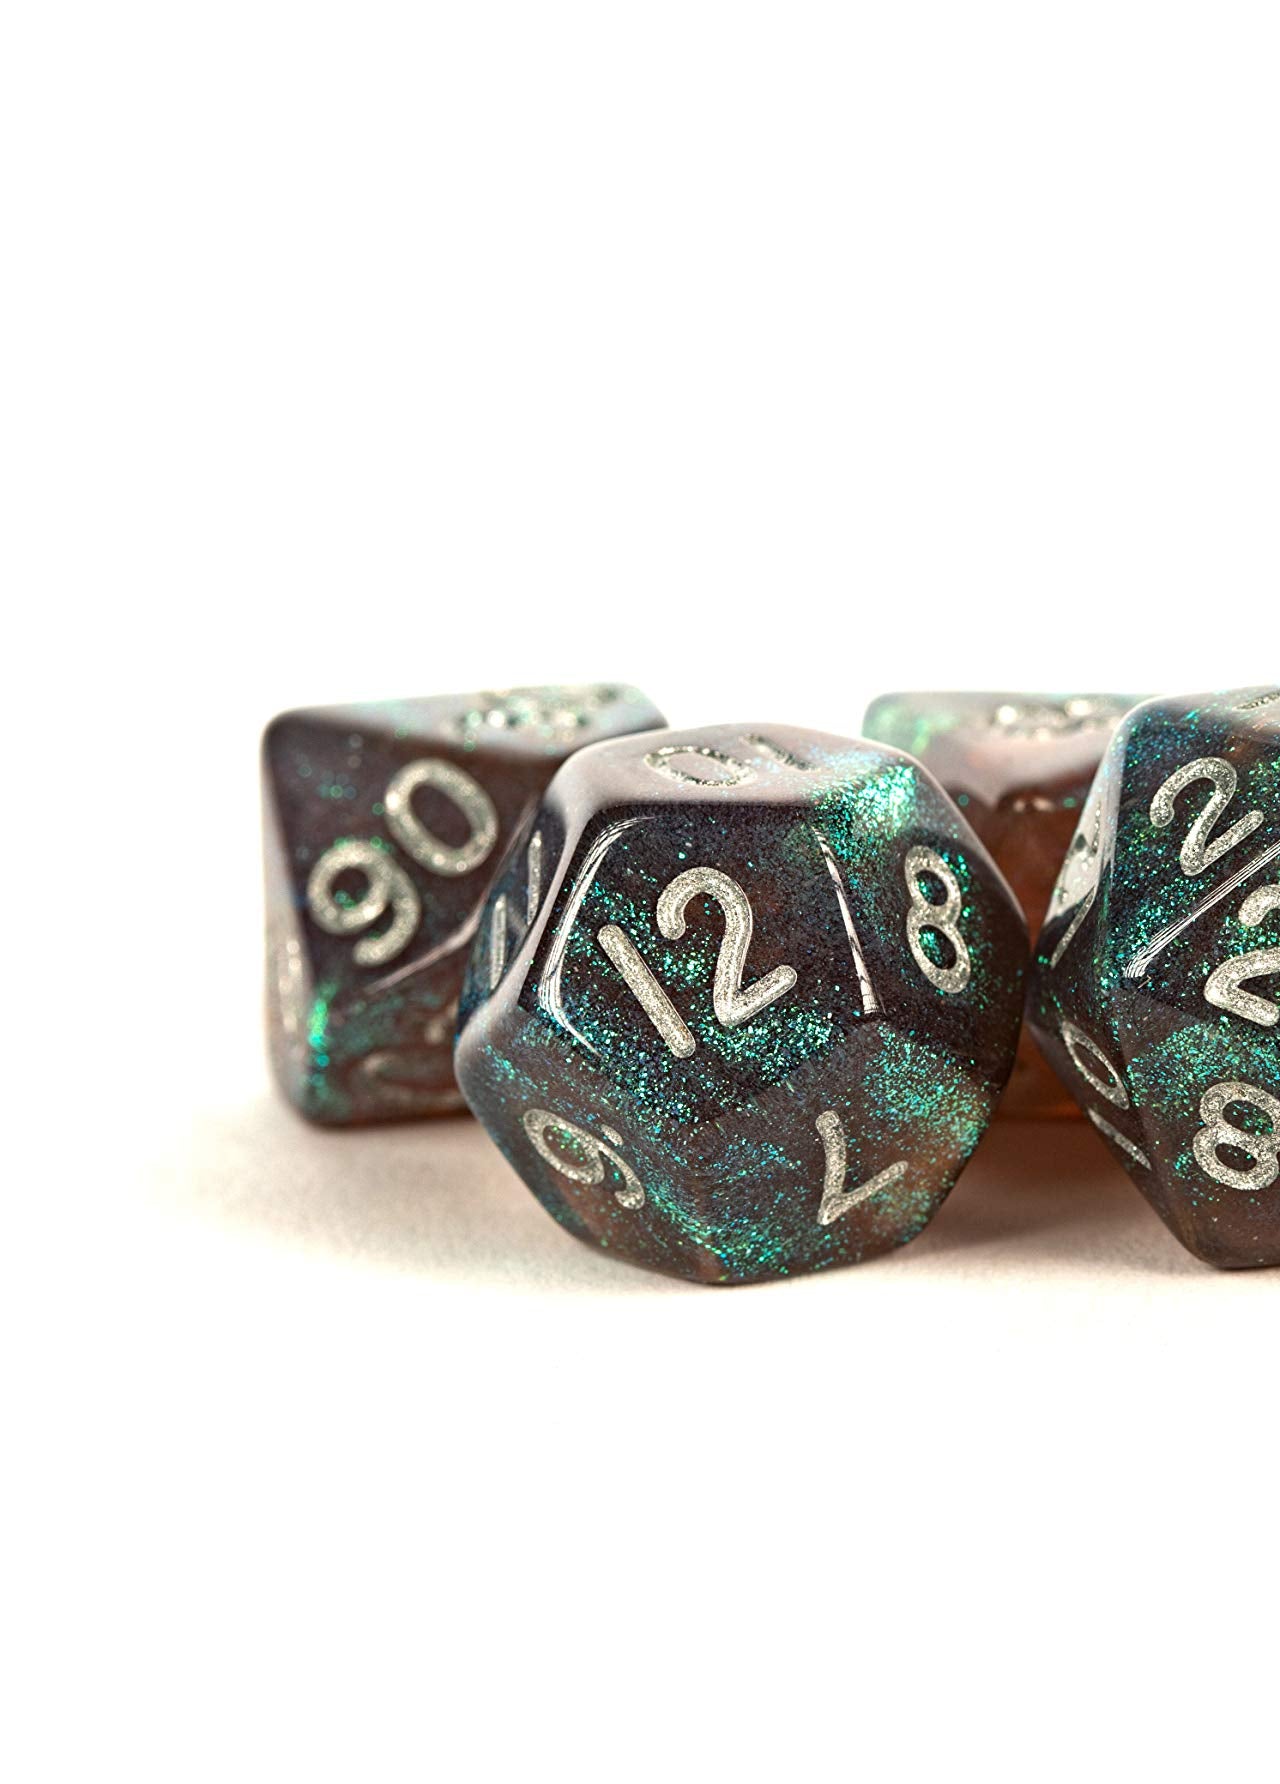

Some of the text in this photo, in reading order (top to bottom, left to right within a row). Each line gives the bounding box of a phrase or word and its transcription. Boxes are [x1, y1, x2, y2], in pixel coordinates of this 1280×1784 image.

[306, 757, 498, 967] 90
[1149, 756, 1264, 877] 2
[598, 866, 798, 1058] 12
[904, 845, 972, 994] 8
[815, 1110, 909, 1225] 7
